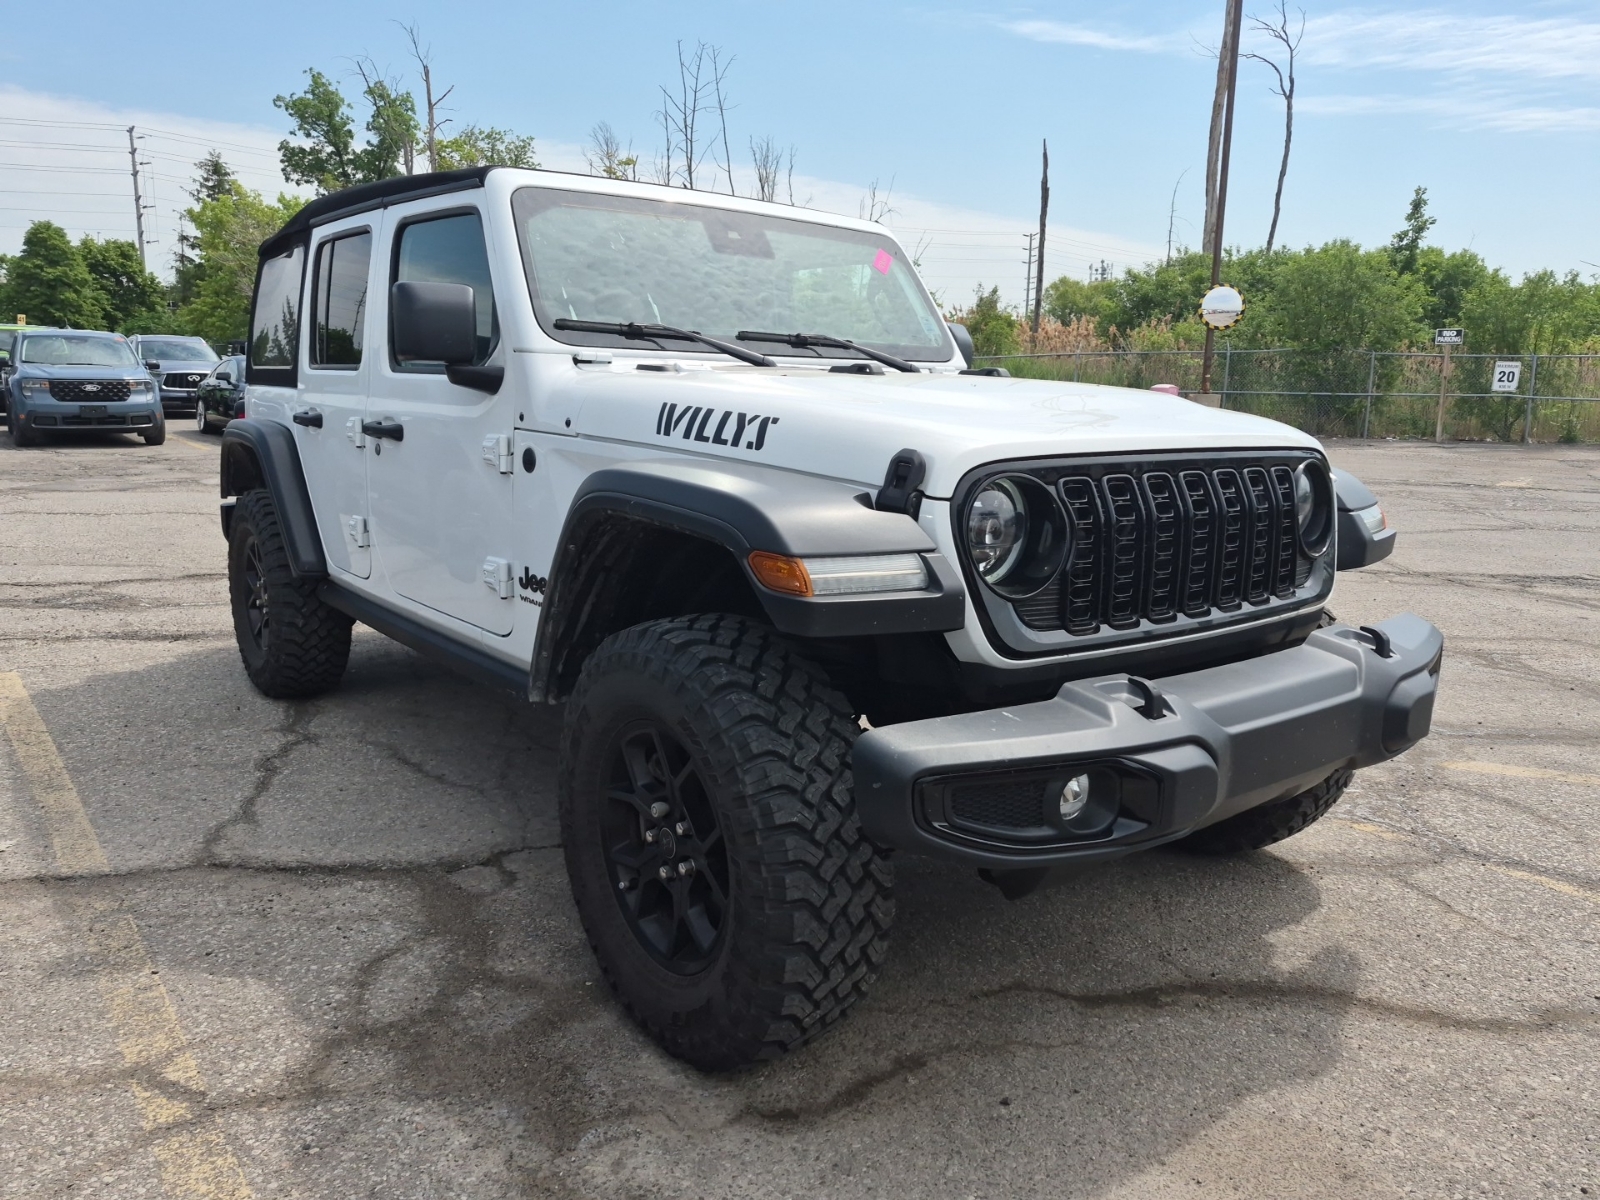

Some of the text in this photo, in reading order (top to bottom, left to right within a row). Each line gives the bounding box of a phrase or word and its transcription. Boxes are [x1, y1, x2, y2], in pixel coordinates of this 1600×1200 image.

[1497, 370, 1516, 383] 20
[656, 402, 780, 451] WILLYS
[519, 566, 547, 596] Jee
